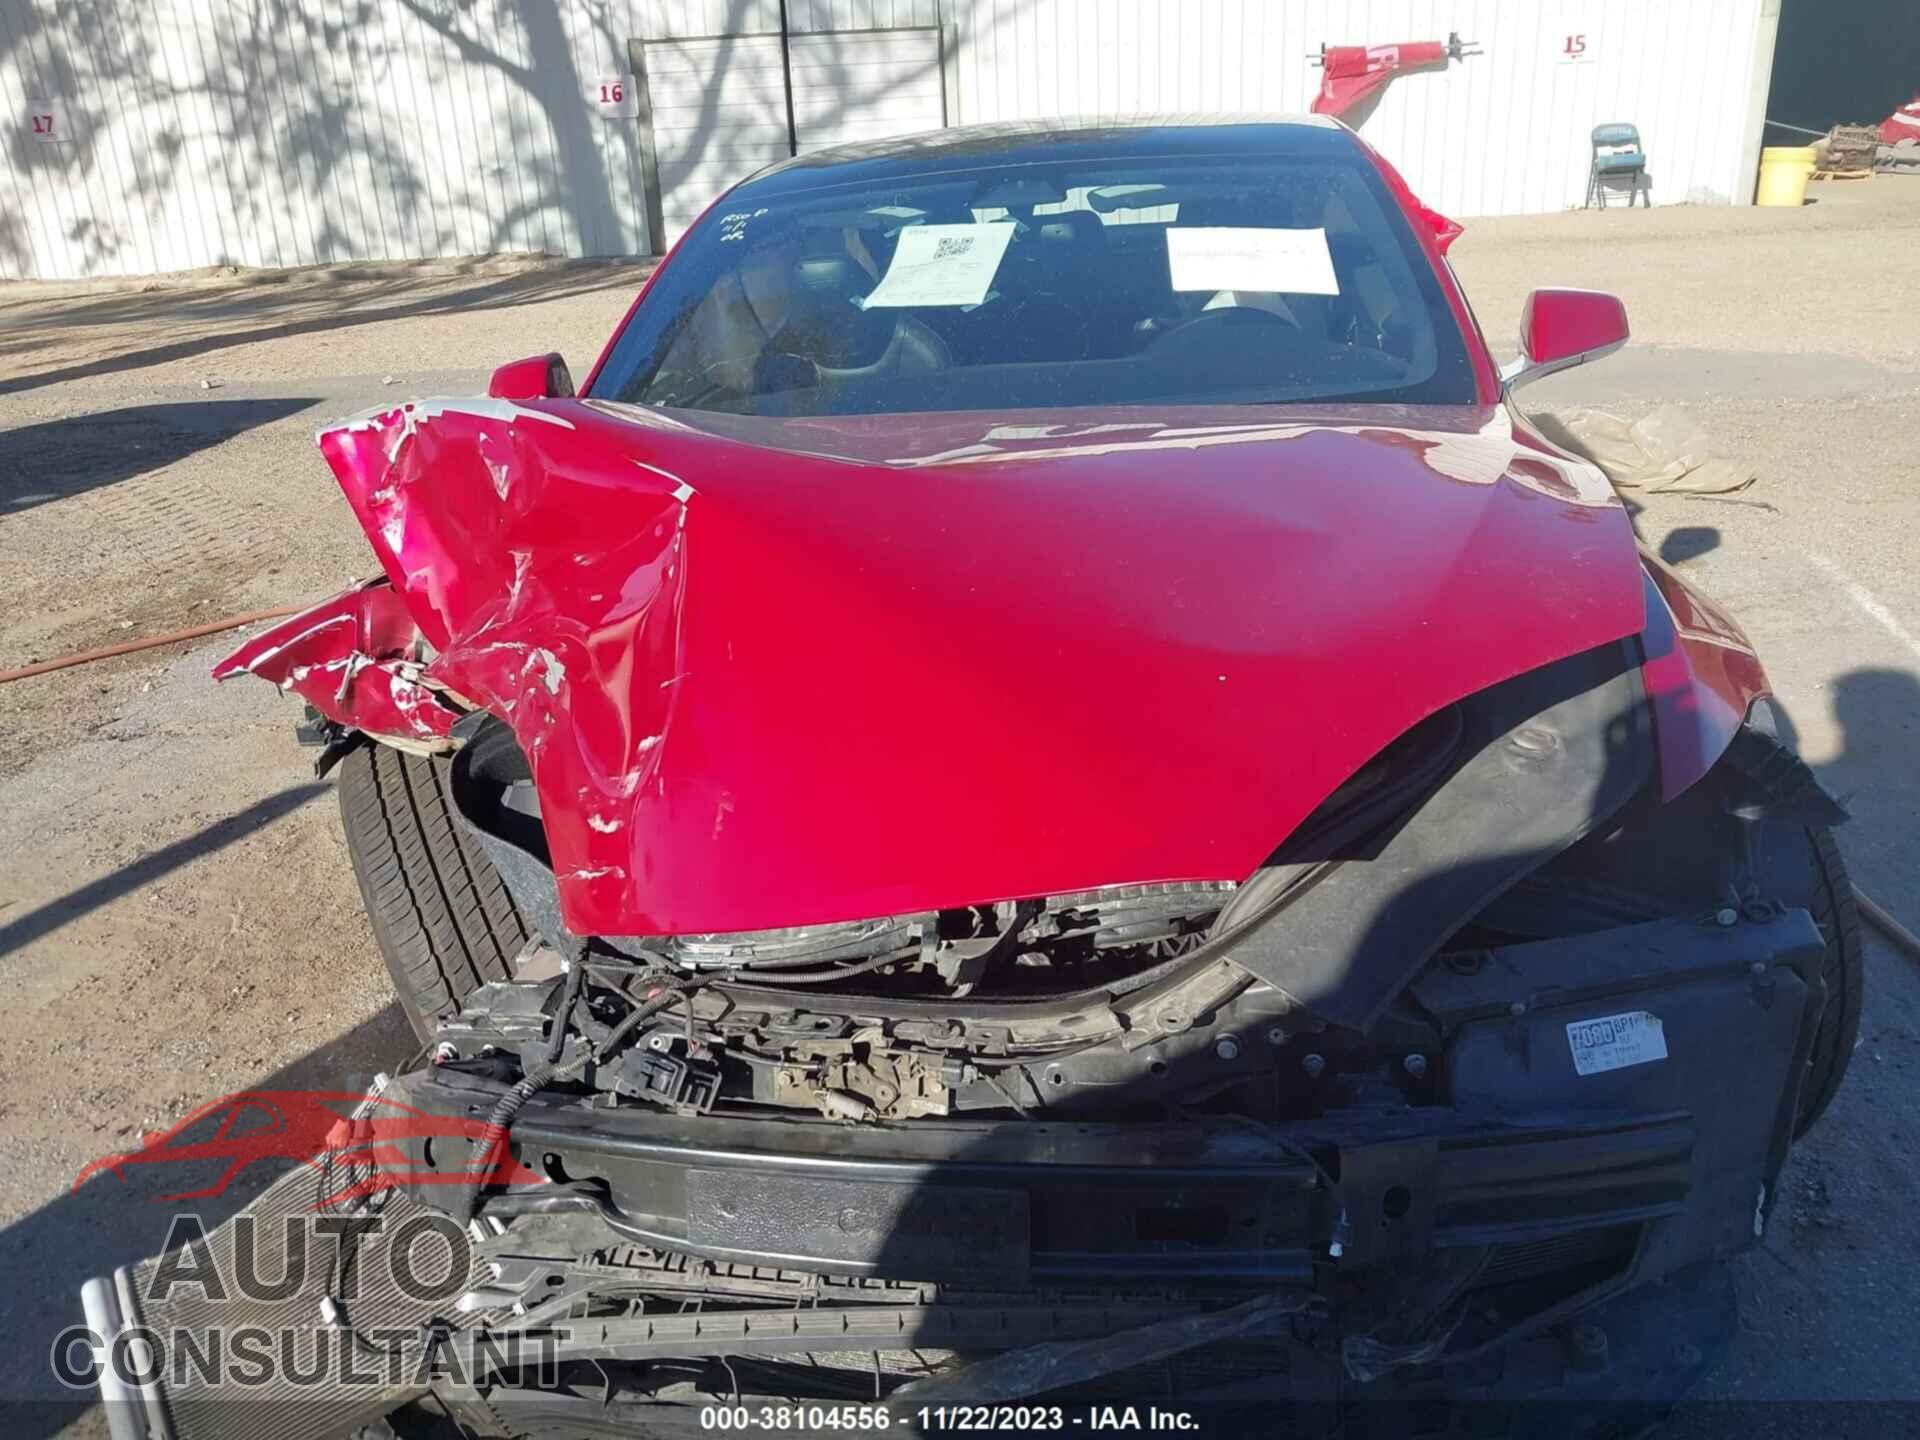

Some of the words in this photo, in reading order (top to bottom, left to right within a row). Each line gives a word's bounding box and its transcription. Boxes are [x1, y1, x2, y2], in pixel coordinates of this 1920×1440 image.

[1563, 35, 1586, 54] 15
[600, 84, 623, 103] 16
[33, 115, 53, 133] 17
